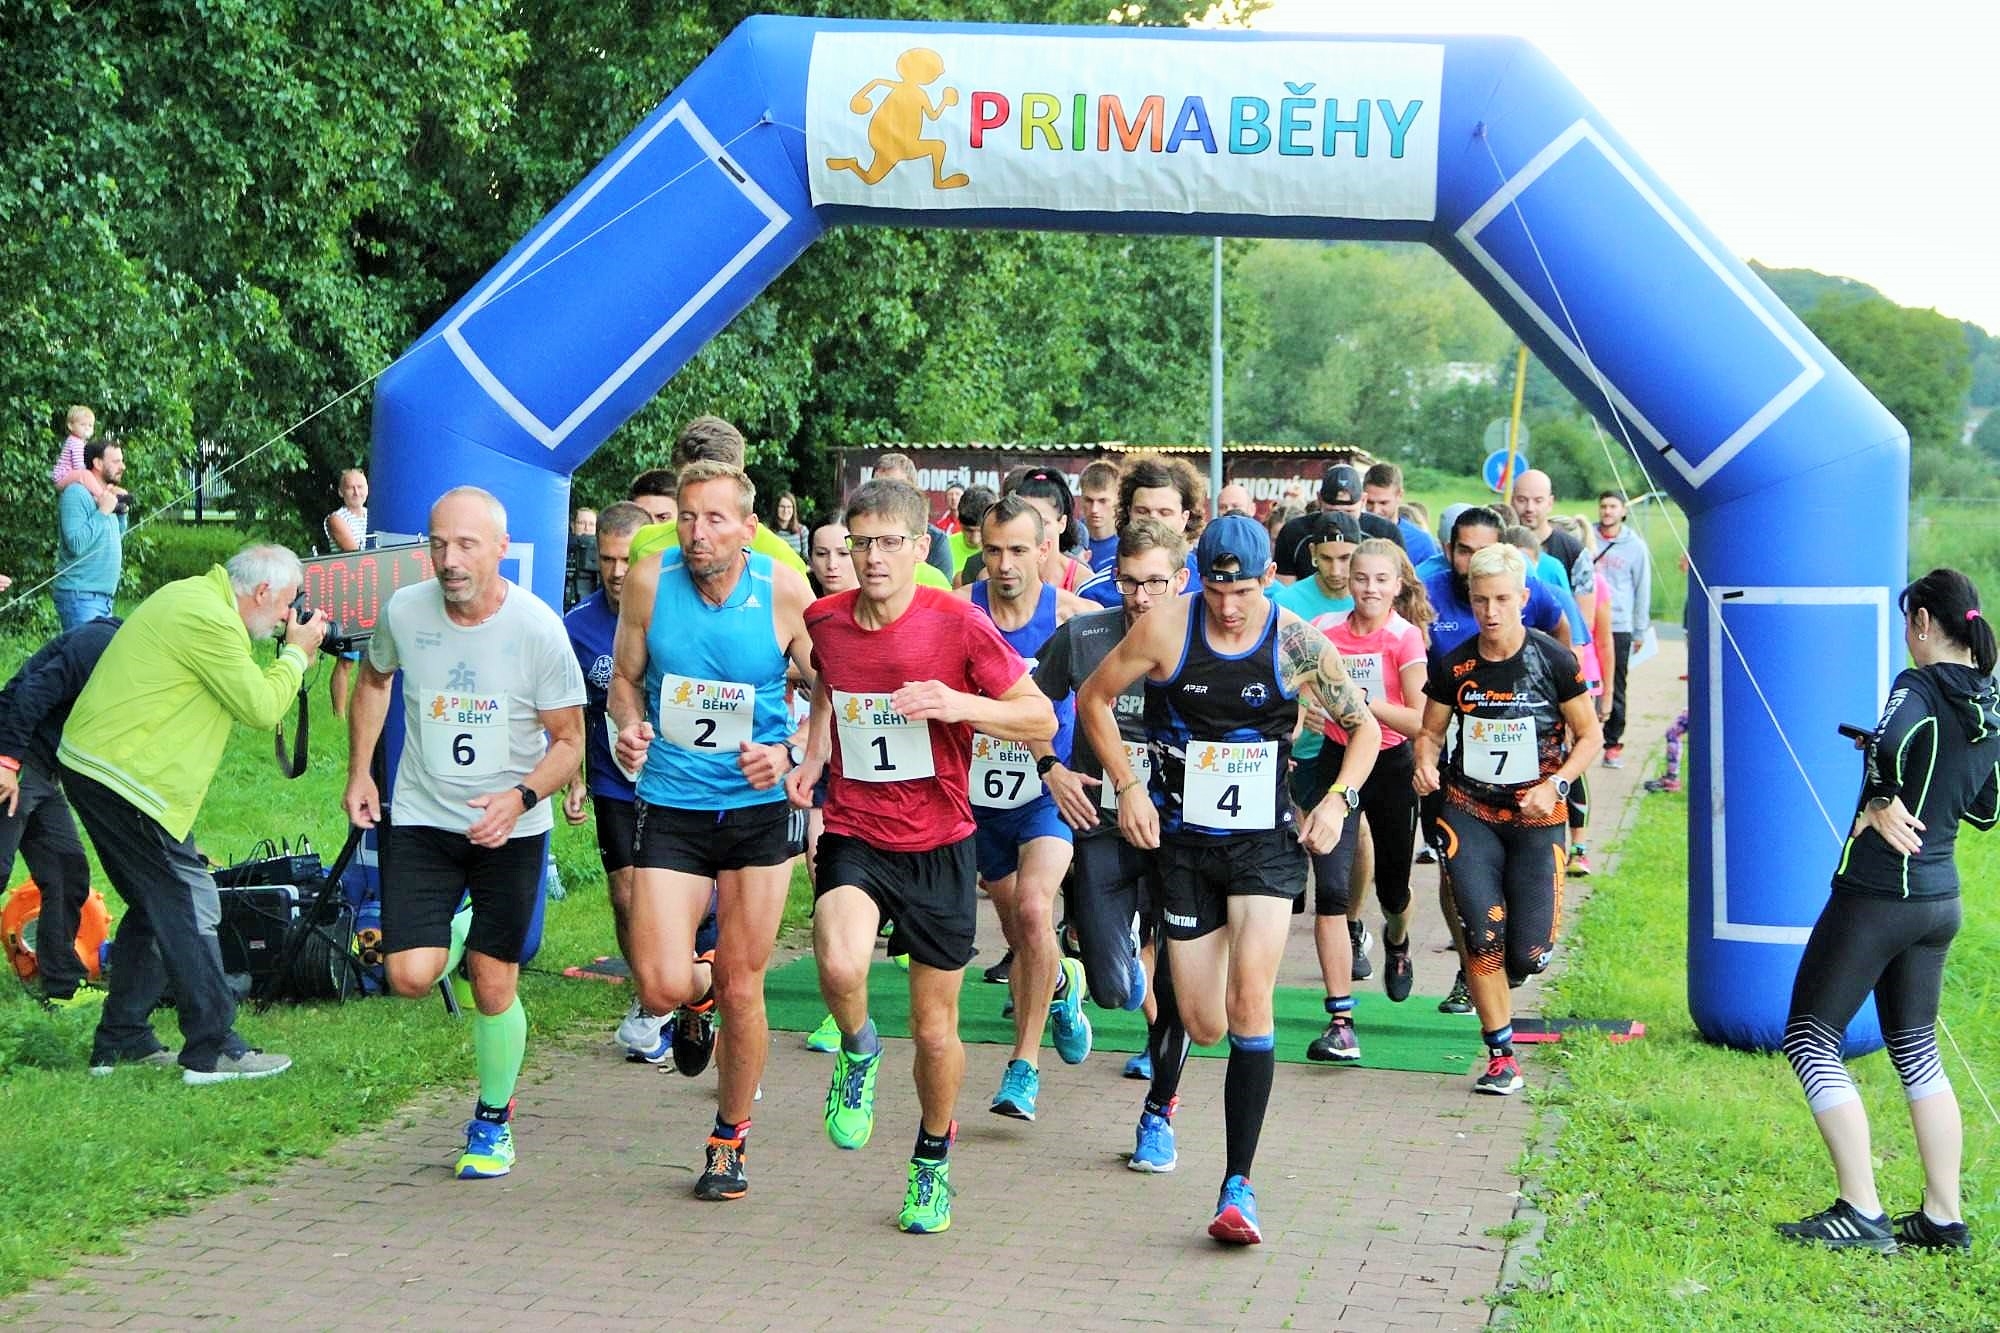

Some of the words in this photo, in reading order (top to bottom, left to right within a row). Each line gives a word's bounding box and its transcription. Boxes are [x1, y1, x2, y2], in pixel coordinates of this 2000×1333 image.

[696, 684, 746, 701] PRIMA
[451, 697, 499, 711] PRIMA
[702, 698, 738, 711] BĚHY
[864, 698, 889, 711] PRI
[457, 711, 493, 724] BĚHY
[693, 718, 717, 748] 2
[1487, 722, 1528, 732] PRIMA
[1494, 732, 1523, 743] BĚHY
[452, 733, 476, 766] 6
[993, 739, 1029, 752] PRIM
[870, 736, 896, 771] 1
[1000, 751, 1030, 763] BĚHY
[1221, 747, 1269, 759] PRIMA
[1227, 760, 1262, 773] BĚHY
[1489, 751, 1509, 776] 7
[984, 769, 1026, 800] 67
[1216, 784, 1242, 818] 4
